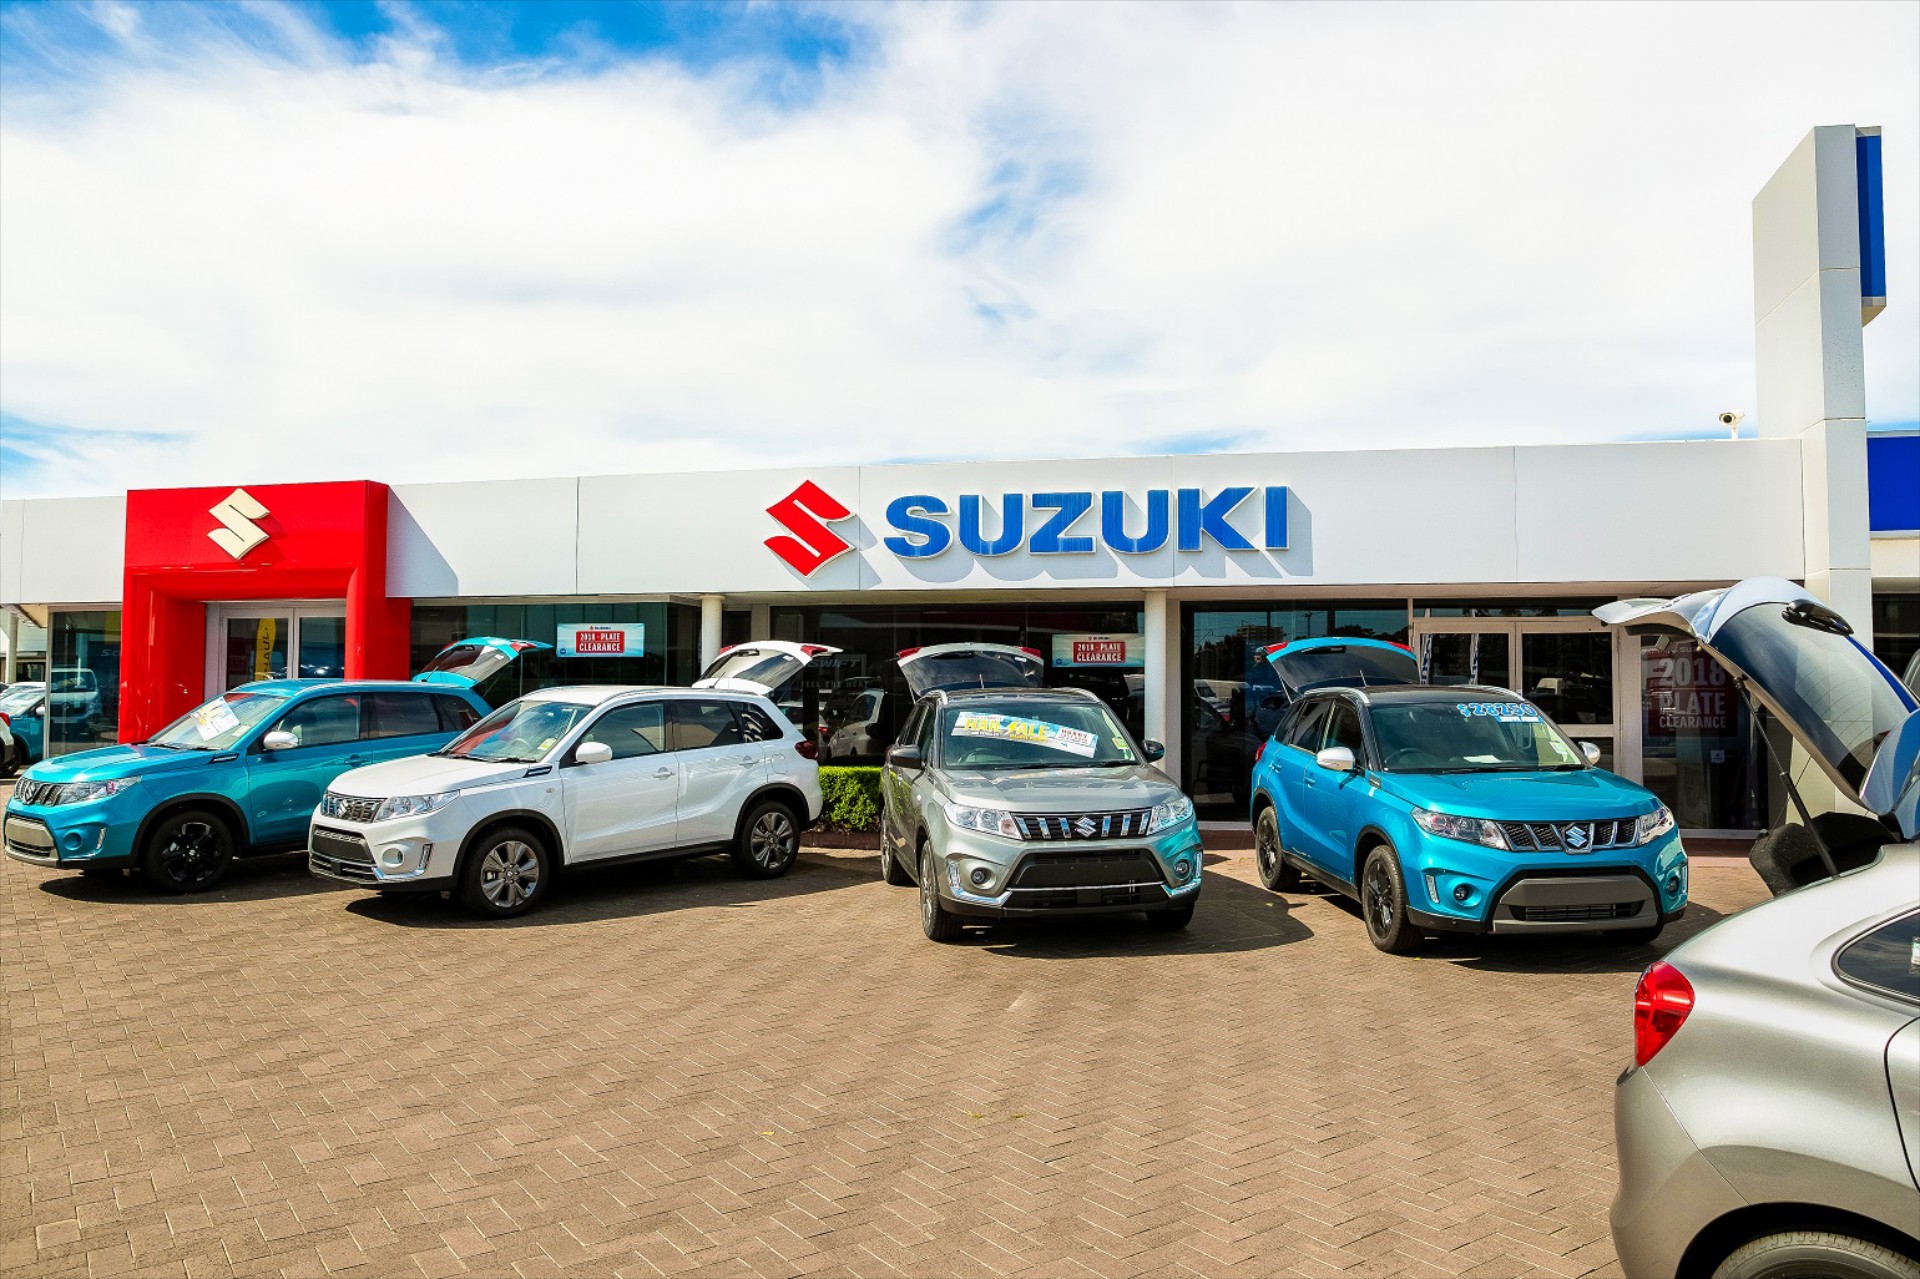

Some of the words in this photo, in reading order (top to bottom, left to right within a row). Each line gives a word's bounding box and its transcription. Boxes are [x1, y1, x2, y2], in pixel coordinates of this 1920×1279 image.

[883, 485, 1290, 559] SUZUKI
[600, 632, 620, 641] PLATE
[579, 643, 620, 651] CLEARANCE
[1077, 643, 1095, 651] 2018
[1076, 653, 1122, 661] CLEARANCE
[808, 658, 861, 668] SWIFT
[1659, 657, 1726, 687] 2018
[1659, 691, 1726, 715] PLATE
[1659, 716, 1727, 729] CLEARANCE
